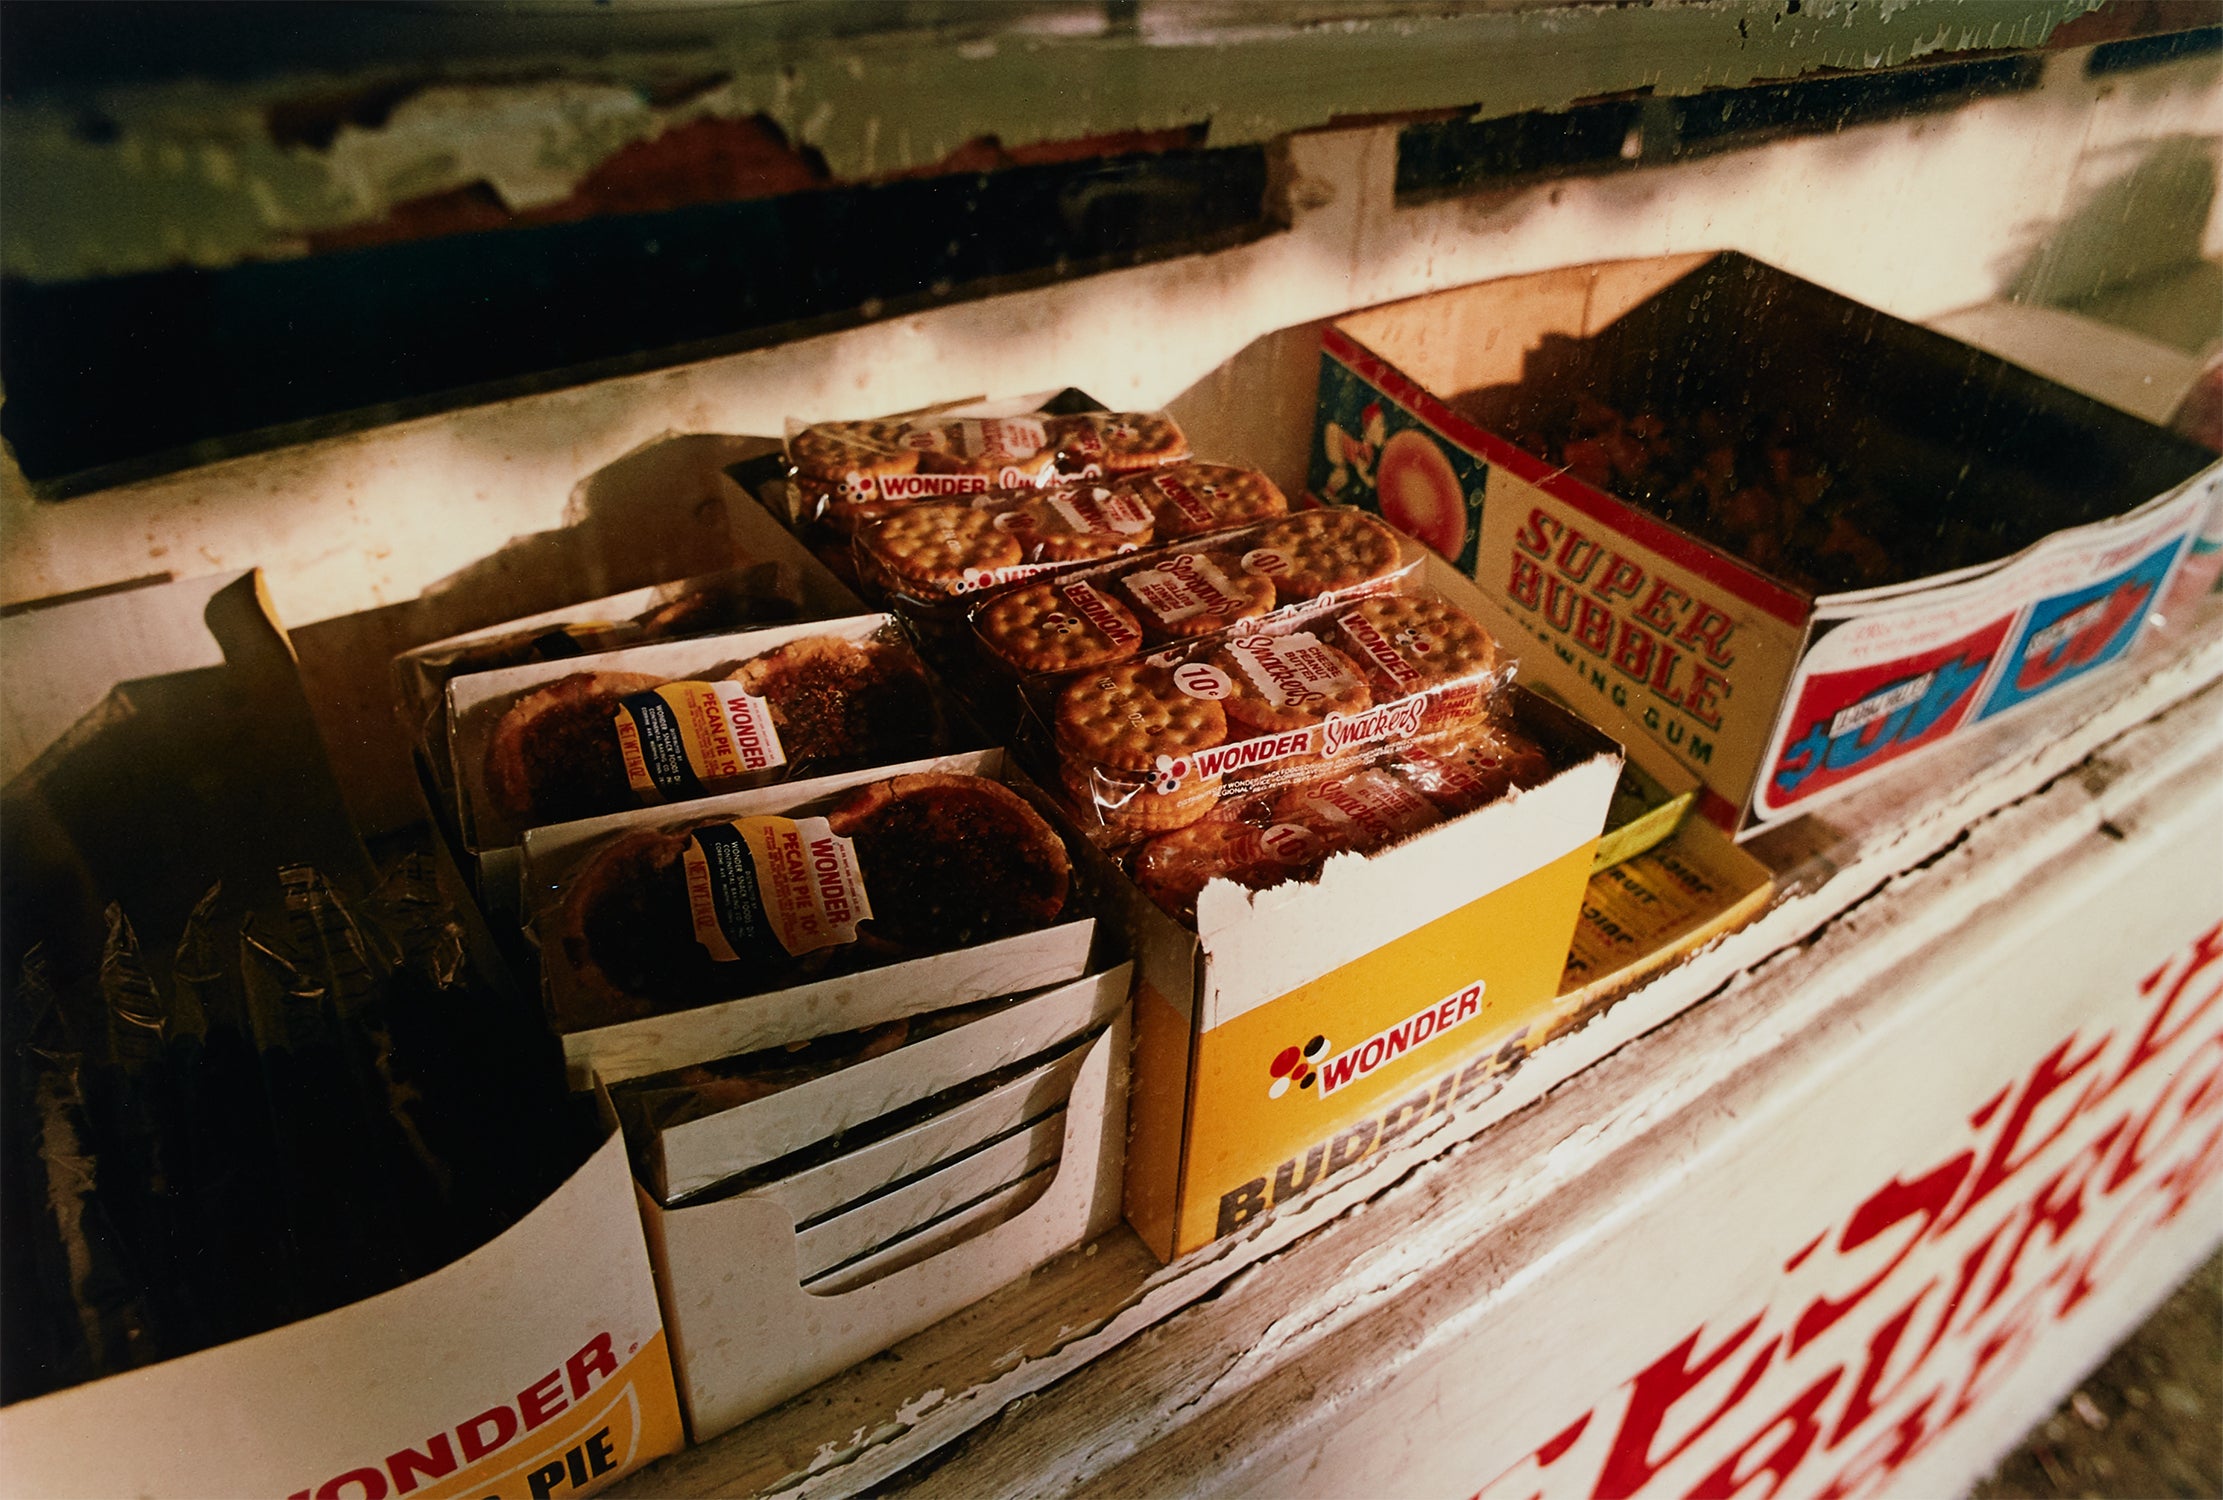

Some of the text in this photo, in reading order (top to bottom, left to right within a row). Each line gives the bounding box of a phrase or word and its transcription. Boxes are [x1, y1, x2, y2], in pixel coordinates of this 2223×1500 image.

[883, 476, 986, 498] WONDER
[1065, 582, 1137, 644] WONDER
[1516, 507, 1737, 669] SUPER
[1235, 636, 1326, 707] Smackers
[1284, 651, 1319, 682] BUTTER
[1296, 649, 1332, 681] PEANUT
[1308, 646, 1342, 679] CHEESE
[1344, 614, 1421, 682] WONDER
[1508, 550, 1734, 732] BUBBLE
[701, 691, 724, 734] PECAN
[714, 735, 730, 756] PIE
[727, 695, 766, 770] WONDER
[1325, 698, 1424, 756] Smackers
[1645, 710, 1714, 765] GUM
[1196, 732, 1309, 778] WONDER
[782, 831, 806, 883] PECAN
[810, 837, 851, 926] WONDER
[793, 884, 812, 909] PIE
[1322, 985, 1482, 1094] WONDER
[526, 1426, 619, 1500] PIE
